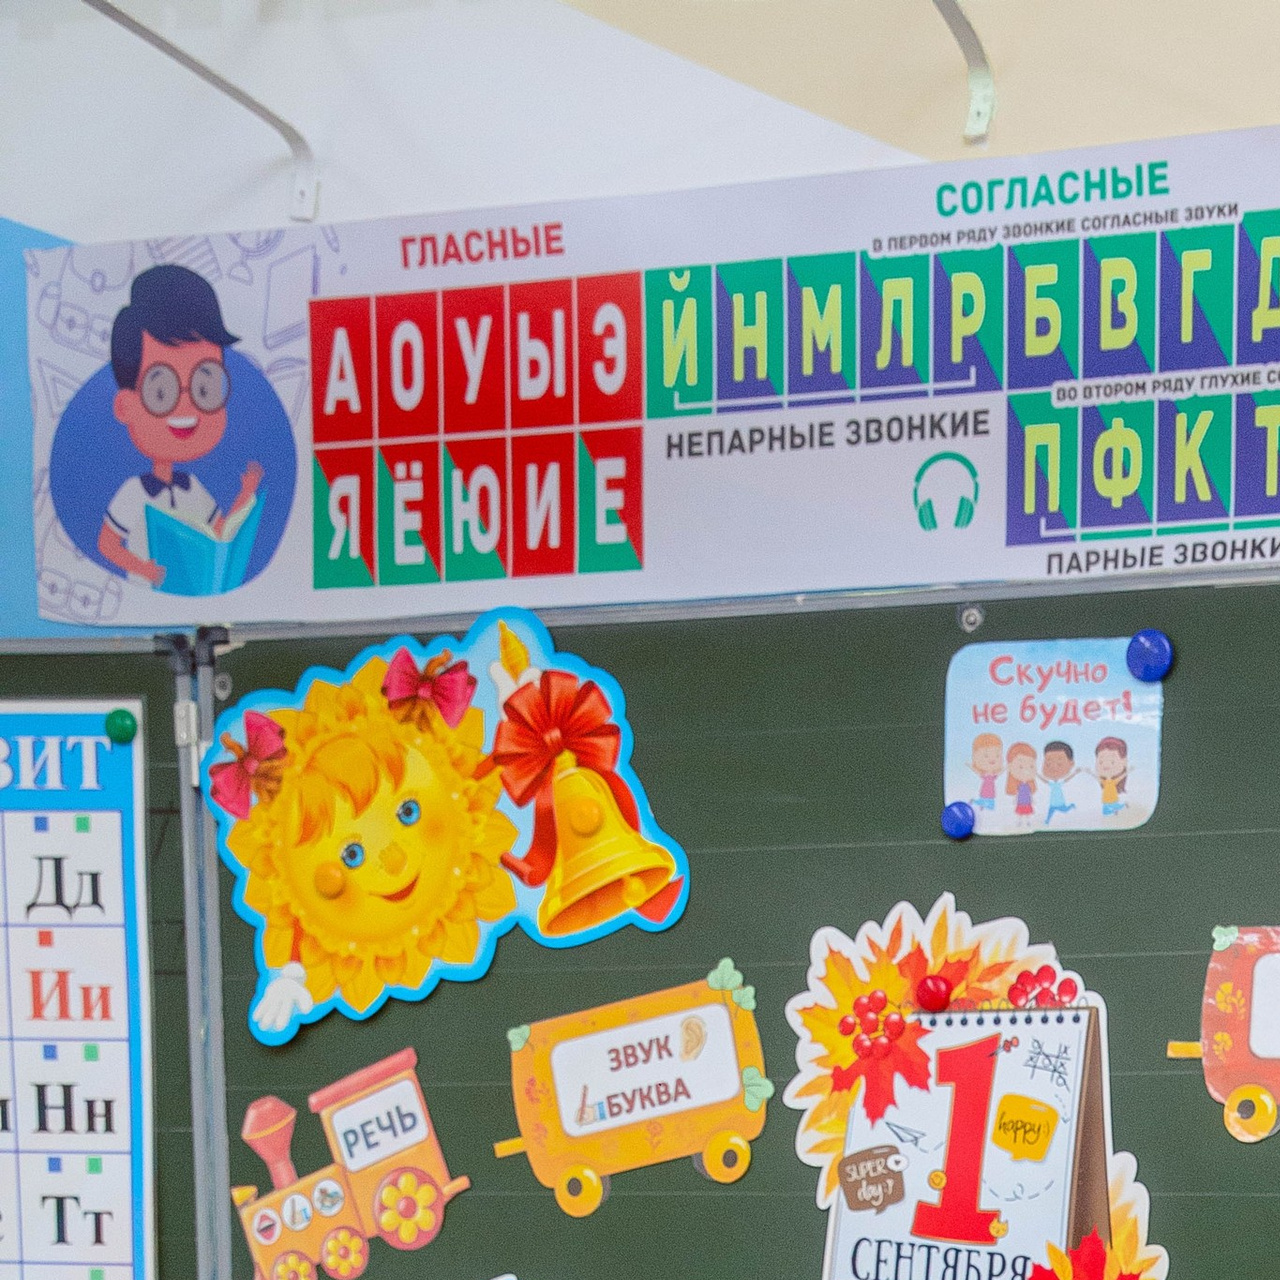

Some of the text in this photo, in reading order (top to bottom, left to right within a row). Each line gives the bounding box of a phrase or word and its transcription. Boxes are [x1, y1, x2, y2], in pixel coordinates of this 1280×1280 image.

[935, 160, 1171, 218] СОГЛАСНЫЕ
[400, 222, 566, 270] ГЛАСНЫЕ
[871, 203, 1240, 253] В ПЕРВОМ РЯДУ ЗВОНКИЕ СОГЛАСНЫЕ ЗВУКИ
[1055, 385, 1078, 402] ВО
[1082, 381, 1147, 400] ВТОРОМ
[1151, 376, 1196, 395] РЯДУ
[1200, 371, 1262, 391] ГЛУХИЕ
[666, 409, 991, 461] НЕПАРНЫЕ ЗВОНКИЕ
[1046, 545, 1165, 575] ПАРНЫЕ
[988, 654, 1109, 693] Скучно
[972, 689, 1134, 731] не будет!
[0, 735, 113, 791] ИТ
[25, 855, 106, 921] Дд
[25, 968, 114, 1022] Ии
[606, 1034, 674, 1072] ЗВУК
[31, 1082, 116, 1135] Нн
[605, 1080, 692, 1118] БУКВА
[342, 1104, 420, 1159] РЕЧЬ
[911, 1032, 1002, 1246] 1
[845, 1157, 888, 1183] SUPER
[40, 1194, 114, 1246] Тт
